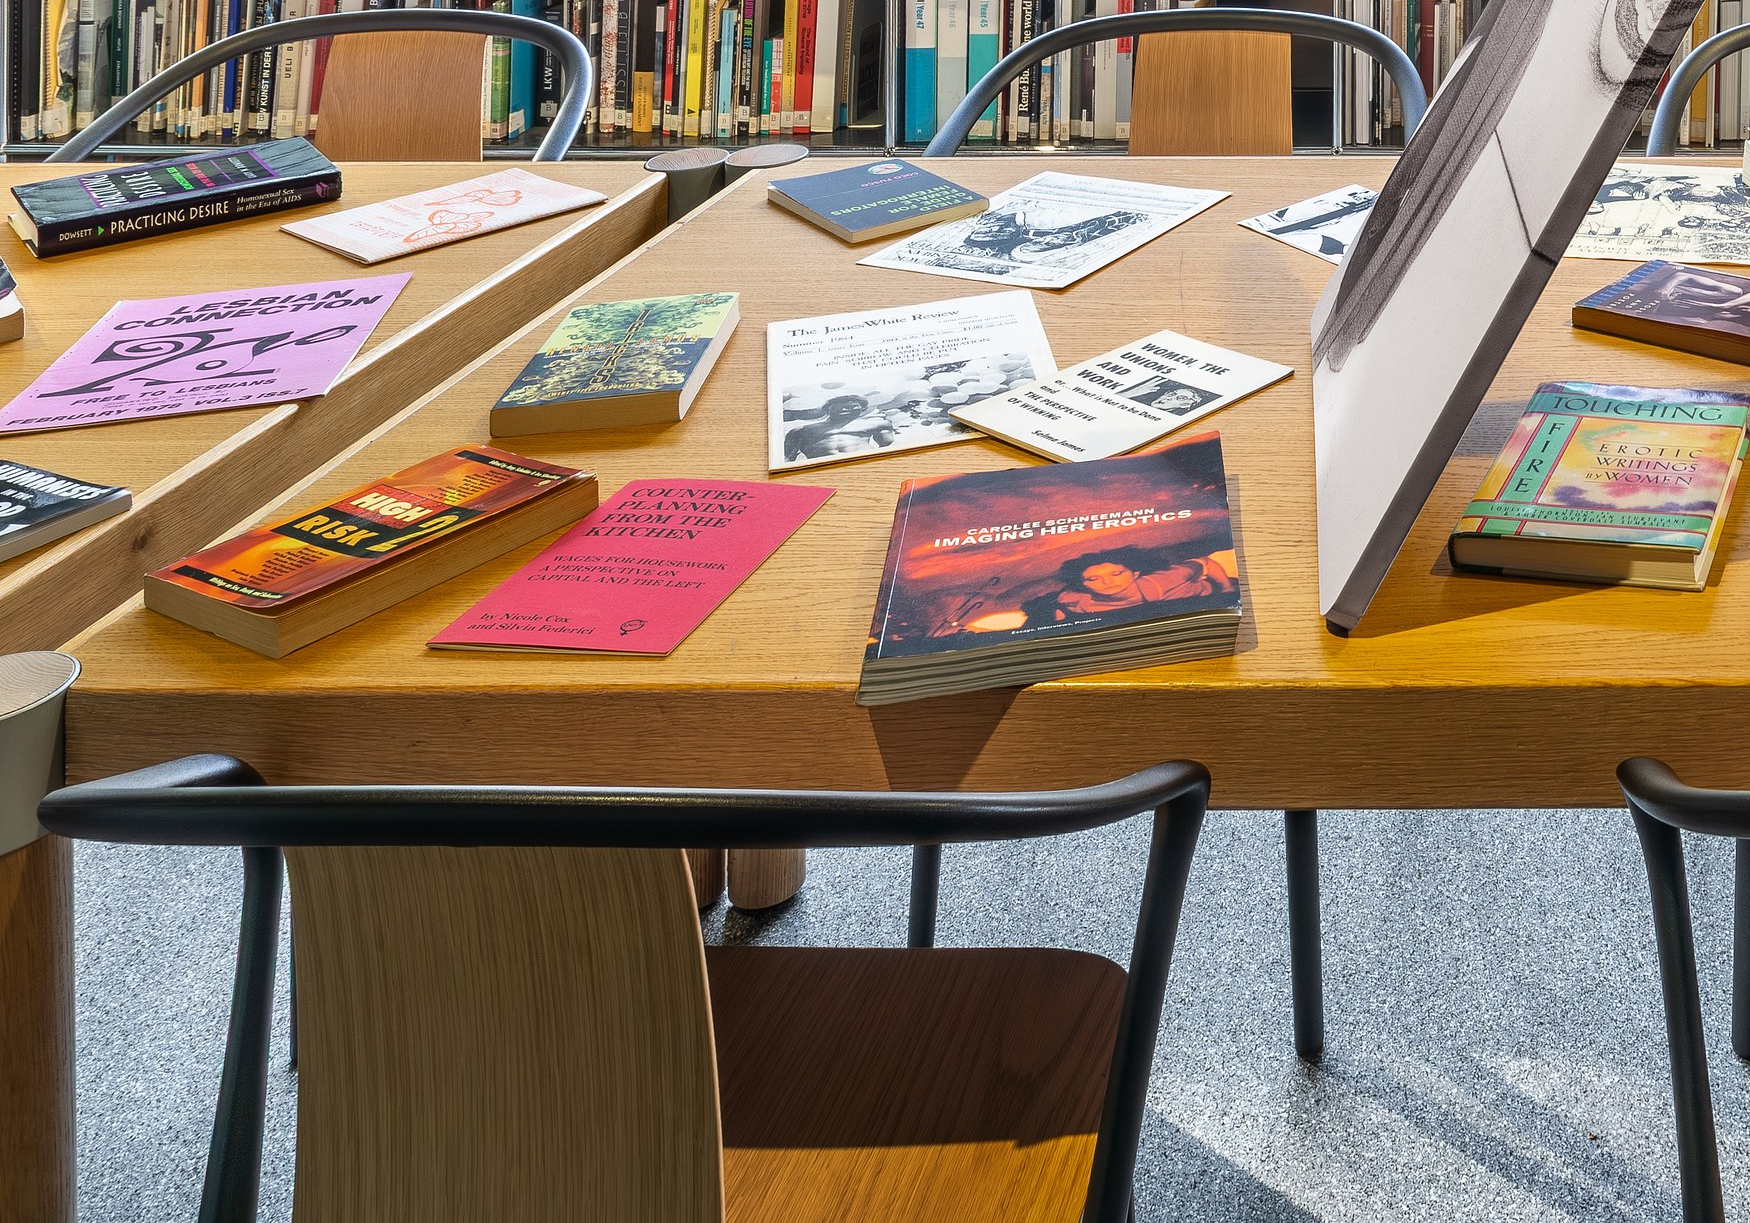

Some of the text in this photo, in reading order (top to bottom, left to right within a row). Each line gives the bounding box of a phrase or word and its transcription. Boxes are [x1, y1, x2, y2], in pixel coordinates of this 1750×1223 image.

[917, 19, 924, 29] 47
[59, 201, 230, 241] DOWSETT PRACTICING DESIRE
[114, 295, 383, 330] CONNECTION
[172, 289, 356, 315] LESBIAN
[1096, 361, 1133, 376] AND
[1119, 351, 1177, 375] UNIONS
[1140, 343, 1230, 376] WOMEN, THE
[1076, 368, 1124, 390] WORK
[71, 379, 278, 405] FREE TO LESBIANS
[6, 389, 308, 426] FEBRUARY 1978 VOL.3 ISS.7
[1552, 396, 1725, 421] TOUCHING
[1514, 422, 1565, 494] FIRE
[1598, 443, 1703, 459] EROTIC
[1596, 456, 1698, 472] WRITINGS
[1586, 472, 1694, 486] BY WOMEN
[614, 499, 747, 516] PLANNING
[630, 488, 756, 502] COUNTER-
[349, 491, 430, 525] HIGH
[598, 513, 732, 528] FROM THE
[294, 514, 375, 547] RISK
[582, 526, 701, 541] KITCHEN
[933, 509, 1192, 548] IMAGING HER EROTICS
[966, 507, 1154, 535] CAROLEE SCHNEEMANN
